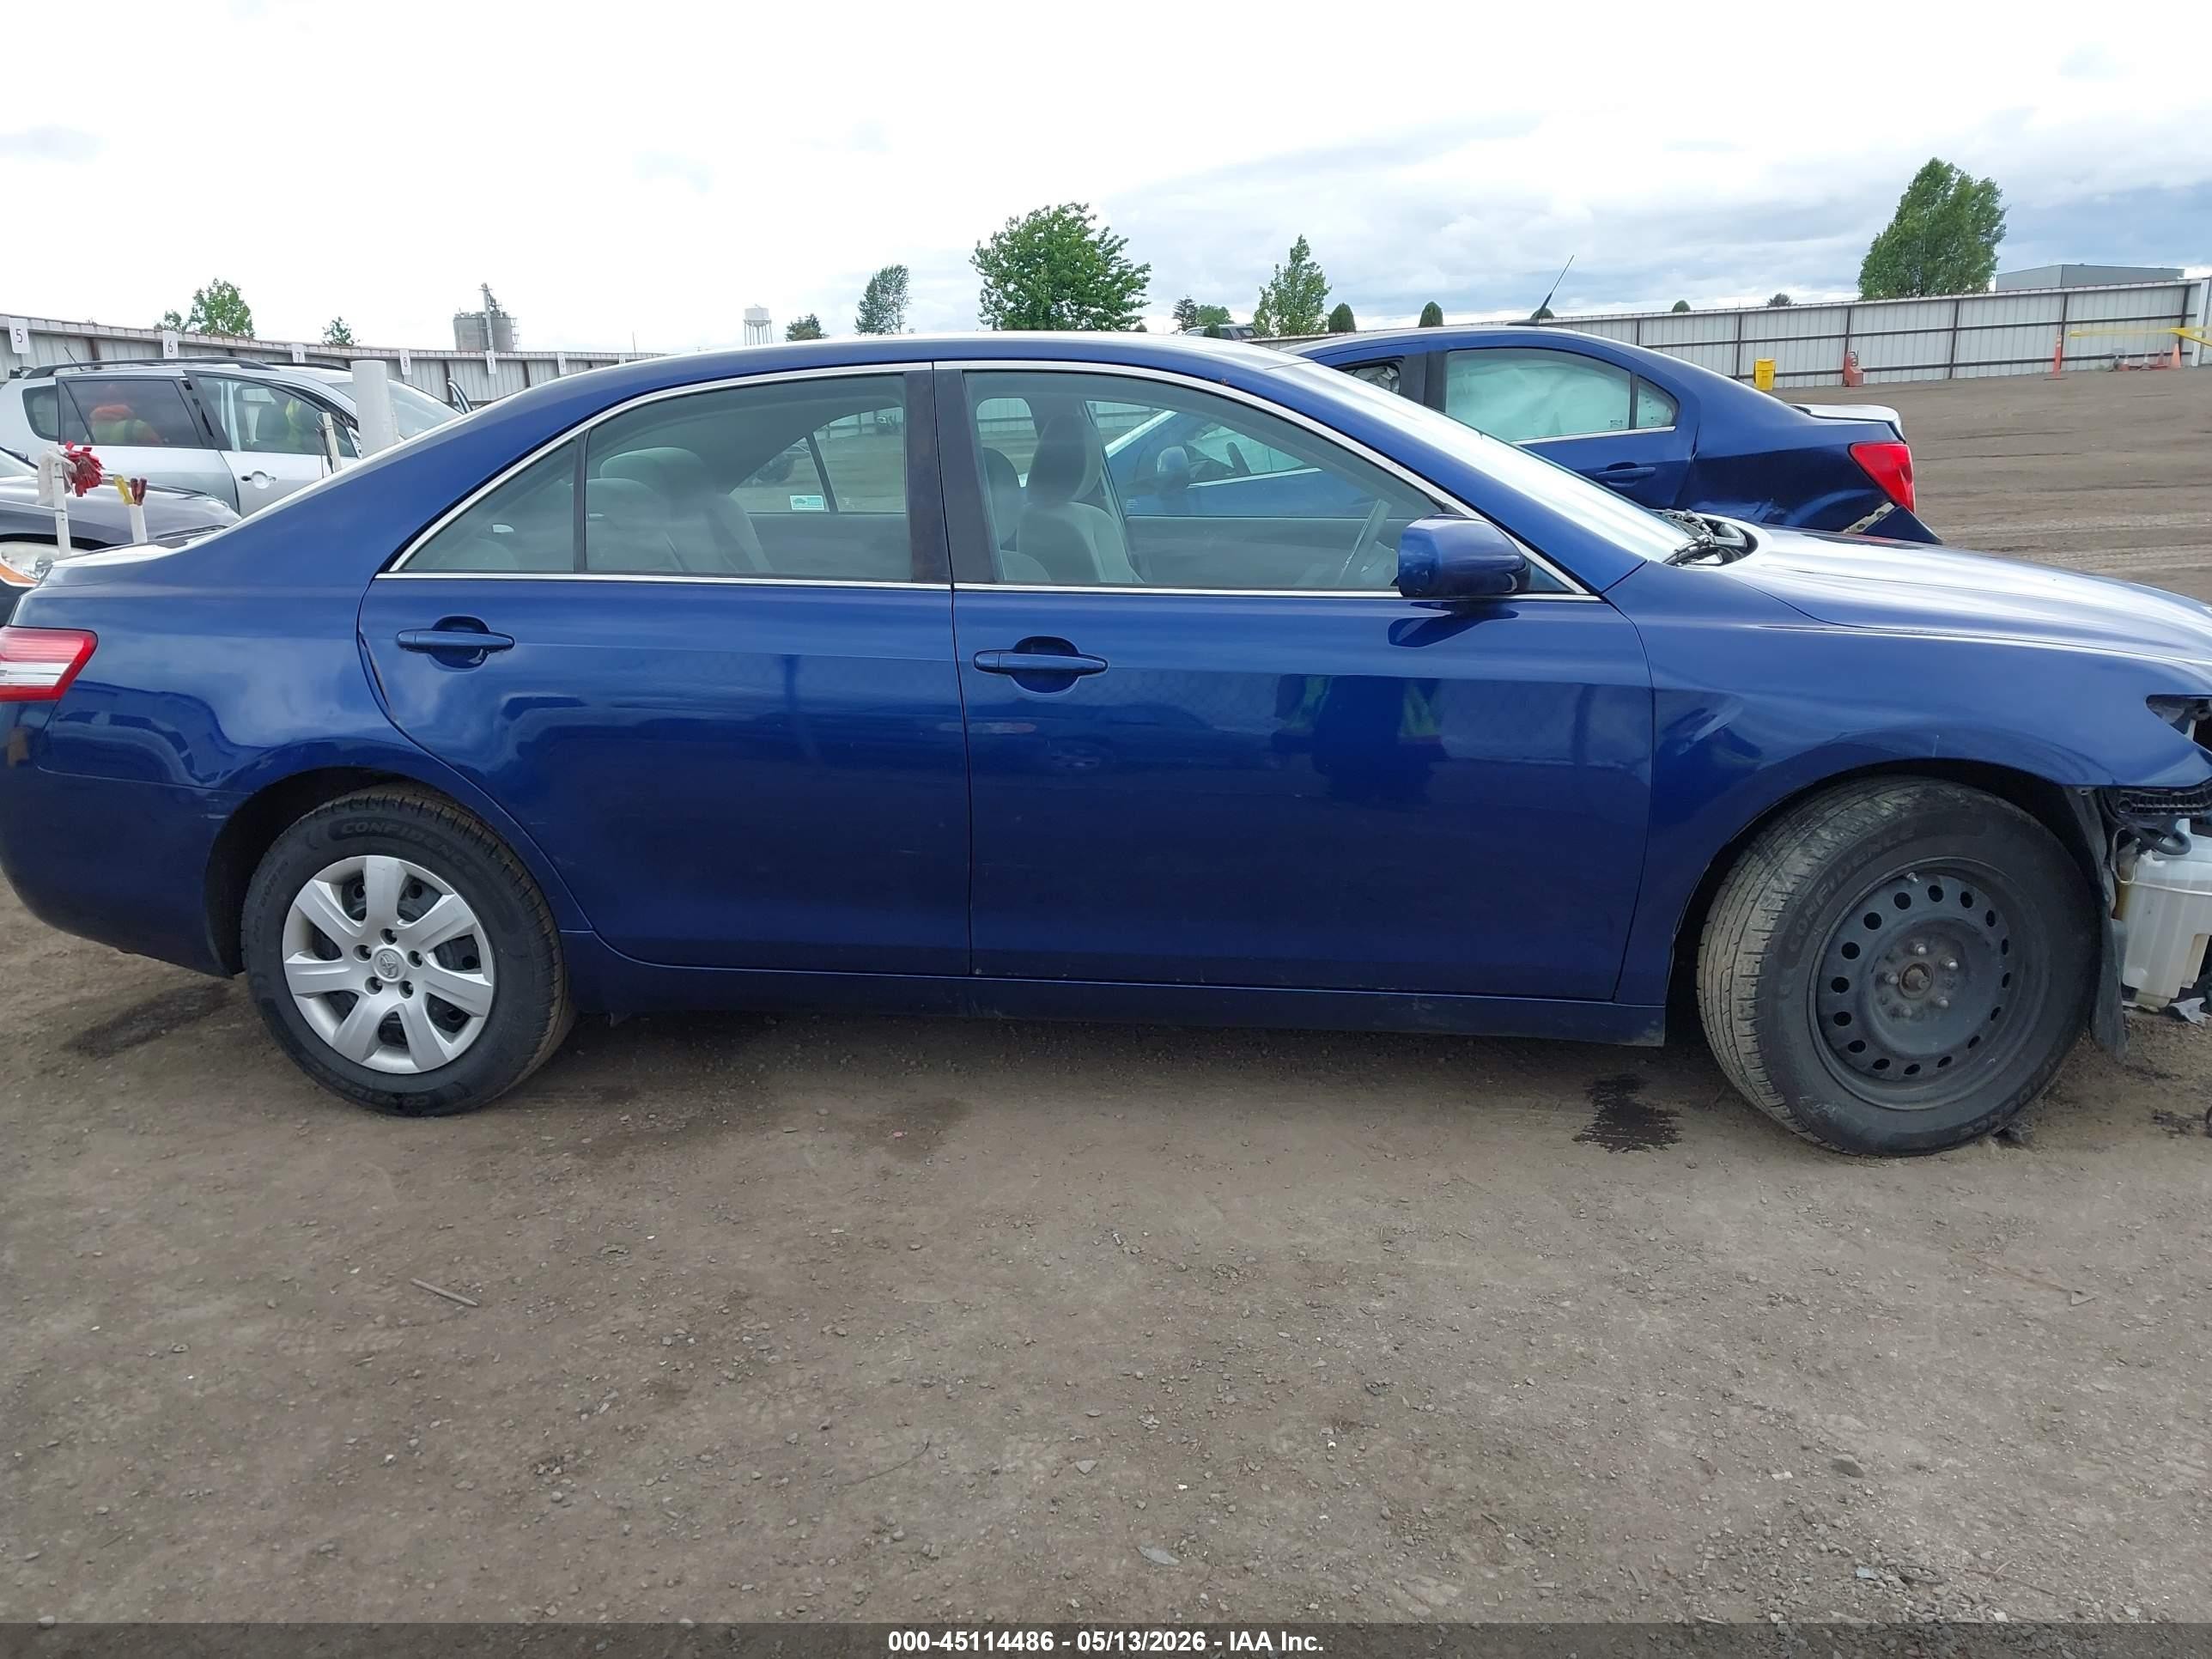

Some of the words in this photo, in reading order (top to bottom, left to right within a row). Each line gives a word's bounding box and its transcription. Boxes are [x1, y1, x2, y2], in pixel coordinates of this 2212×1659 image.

[15, 328, 23, 343] 5
[167, 340, 173, 353] 6
[296, 352, 301, 362] 7
[403, 356, 408, 368] 8
[489, 357, 494, 367] 9
[559, 357, 565, 368] 10
[341, 820, 479, 874] CONFIDENCE
